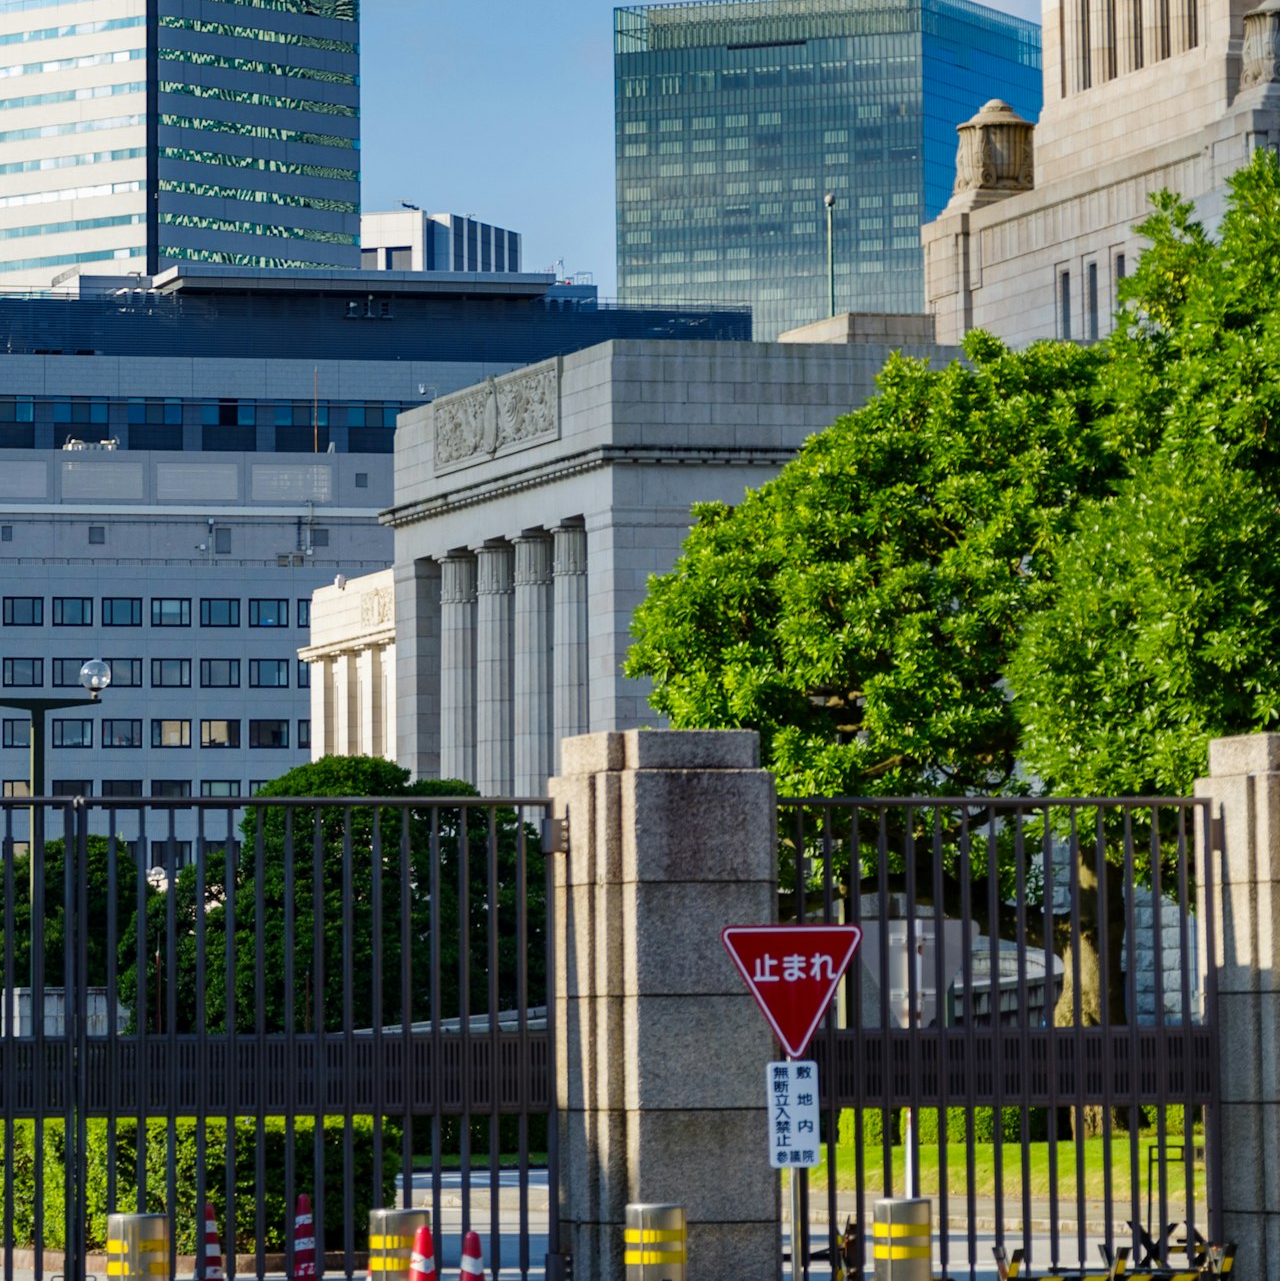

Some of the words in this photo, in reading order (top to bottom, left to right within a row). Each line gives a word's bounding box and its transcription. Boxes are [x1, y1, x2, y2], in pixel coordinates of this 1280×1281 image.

[753, 953, 838, 982] 止まれ
[773, 1066, 792, 1147] 無断立入禁止
[796, 1066, 814, 1133] 敷地内
[776, 1150, 815, 1163] 参議院
